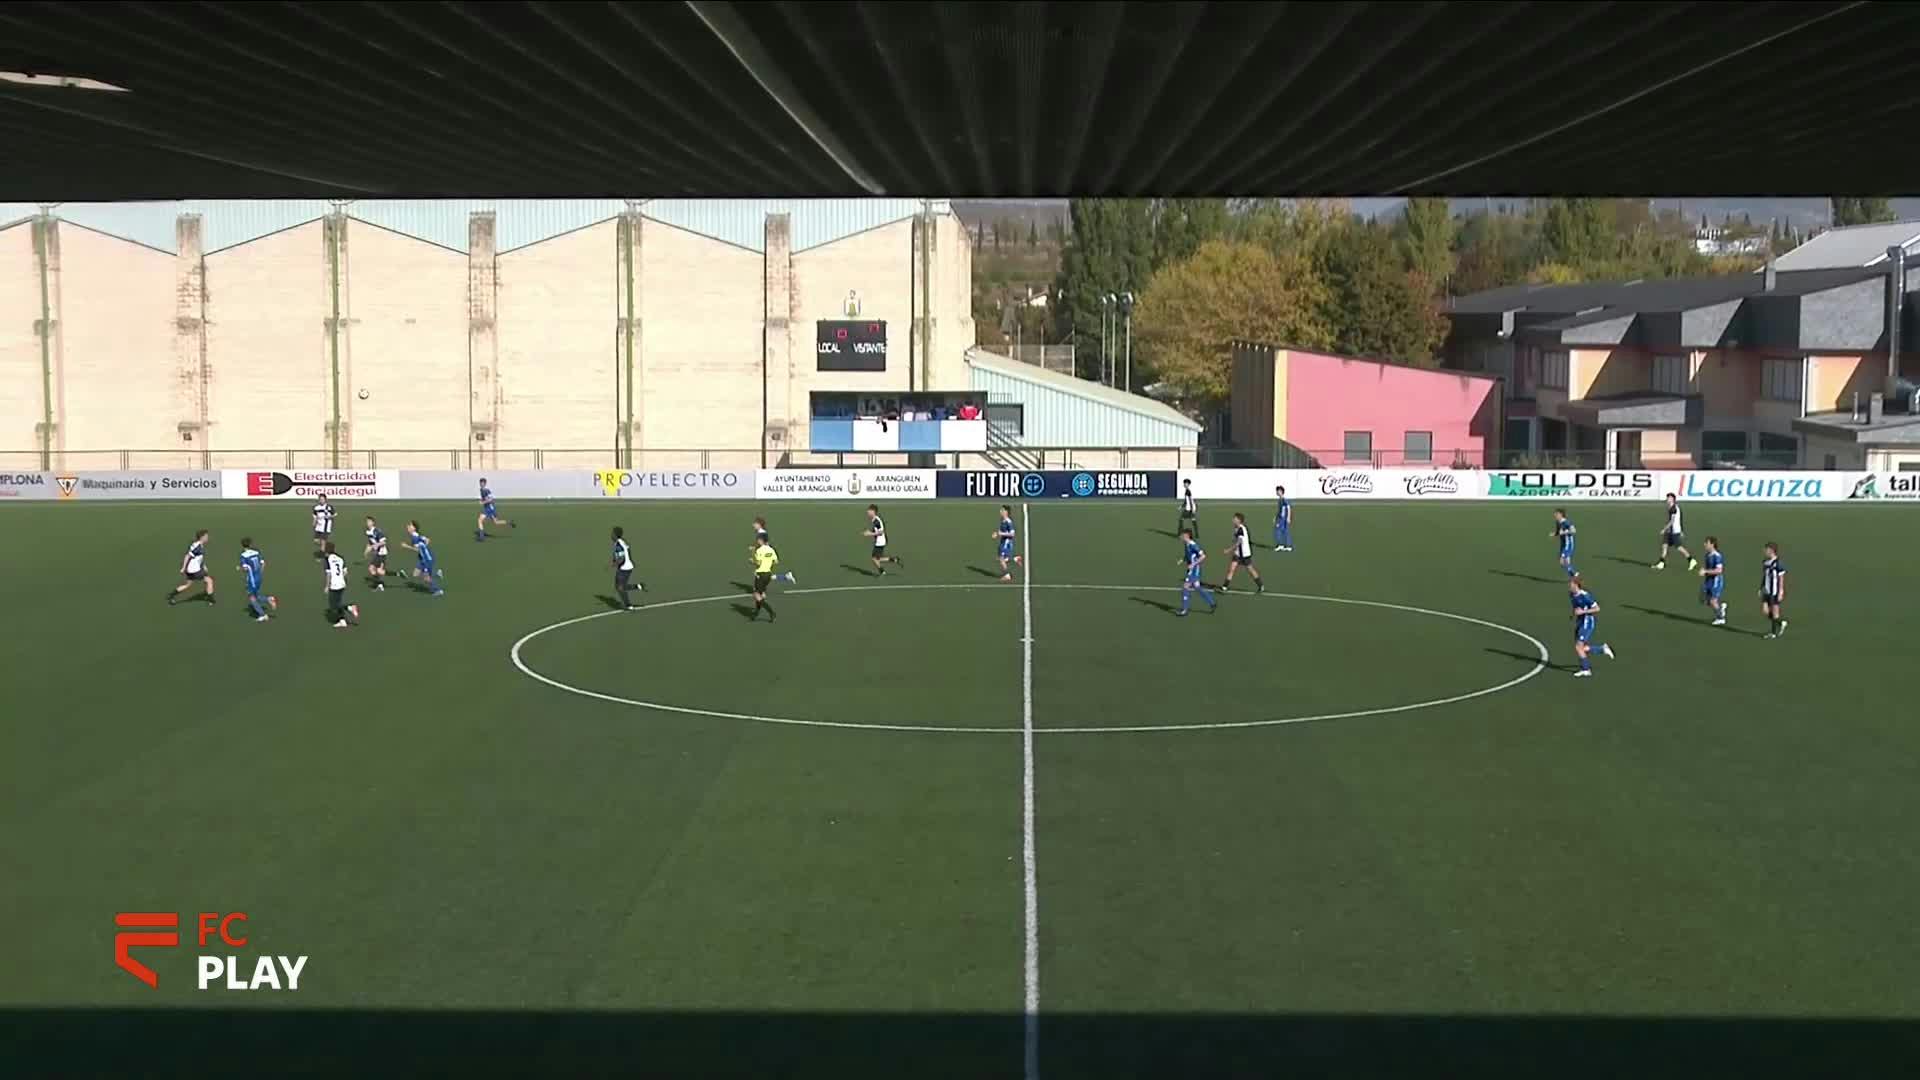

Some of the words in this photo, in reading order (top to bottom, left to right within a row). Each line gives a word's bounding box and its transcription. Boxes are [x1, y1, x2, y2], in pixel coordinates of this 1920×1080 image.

[818, 342, 841, 353] LOCAL
[82, 478, 145, 489] Maquinaria
[149, 479, 157, 489] y
[162, 477, 217, 489] Servicios
[294, 472, 376, 481] Electricidad
[593, 472, 737, 487] PROYELECTRO
[1097, 473, 1148, 489] SEGUNDA
[1498, 473, 1652, 488] TOLDOS
[1889, 475, 1920, 491] tal
[296, 487, 377, 497] Oficialdegui
[335, 563, 342, 577] 3
